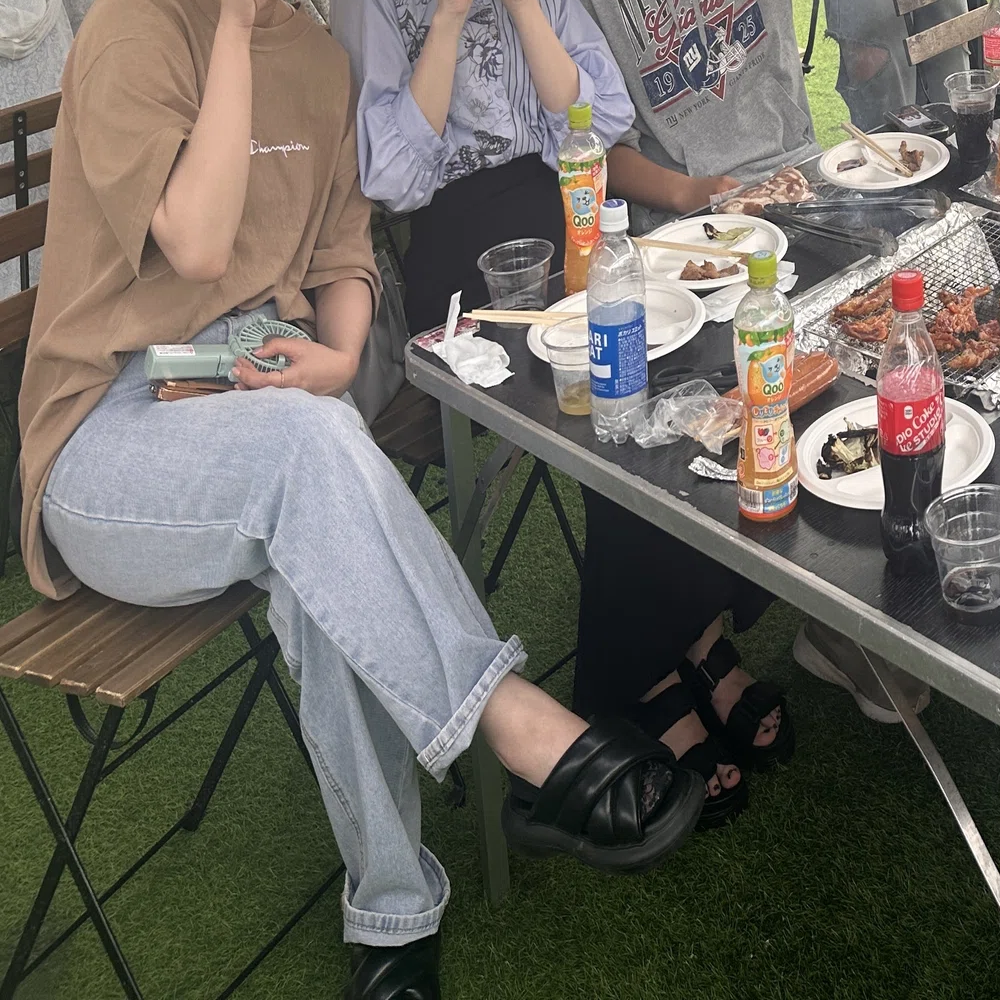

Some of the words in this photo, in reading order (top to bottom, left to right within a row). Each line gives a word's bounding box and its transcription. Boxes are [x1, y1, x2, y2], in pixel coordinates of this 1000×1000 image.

[737, 15, 756, 44] 25
[653, 71, 675, 98] 19
[250, 139, 310, 158] Champion
[573, 215, 595, 227] Qoo
[763, 382, 784, 395] Qoo
[912, 401, 936, 430] Coke
